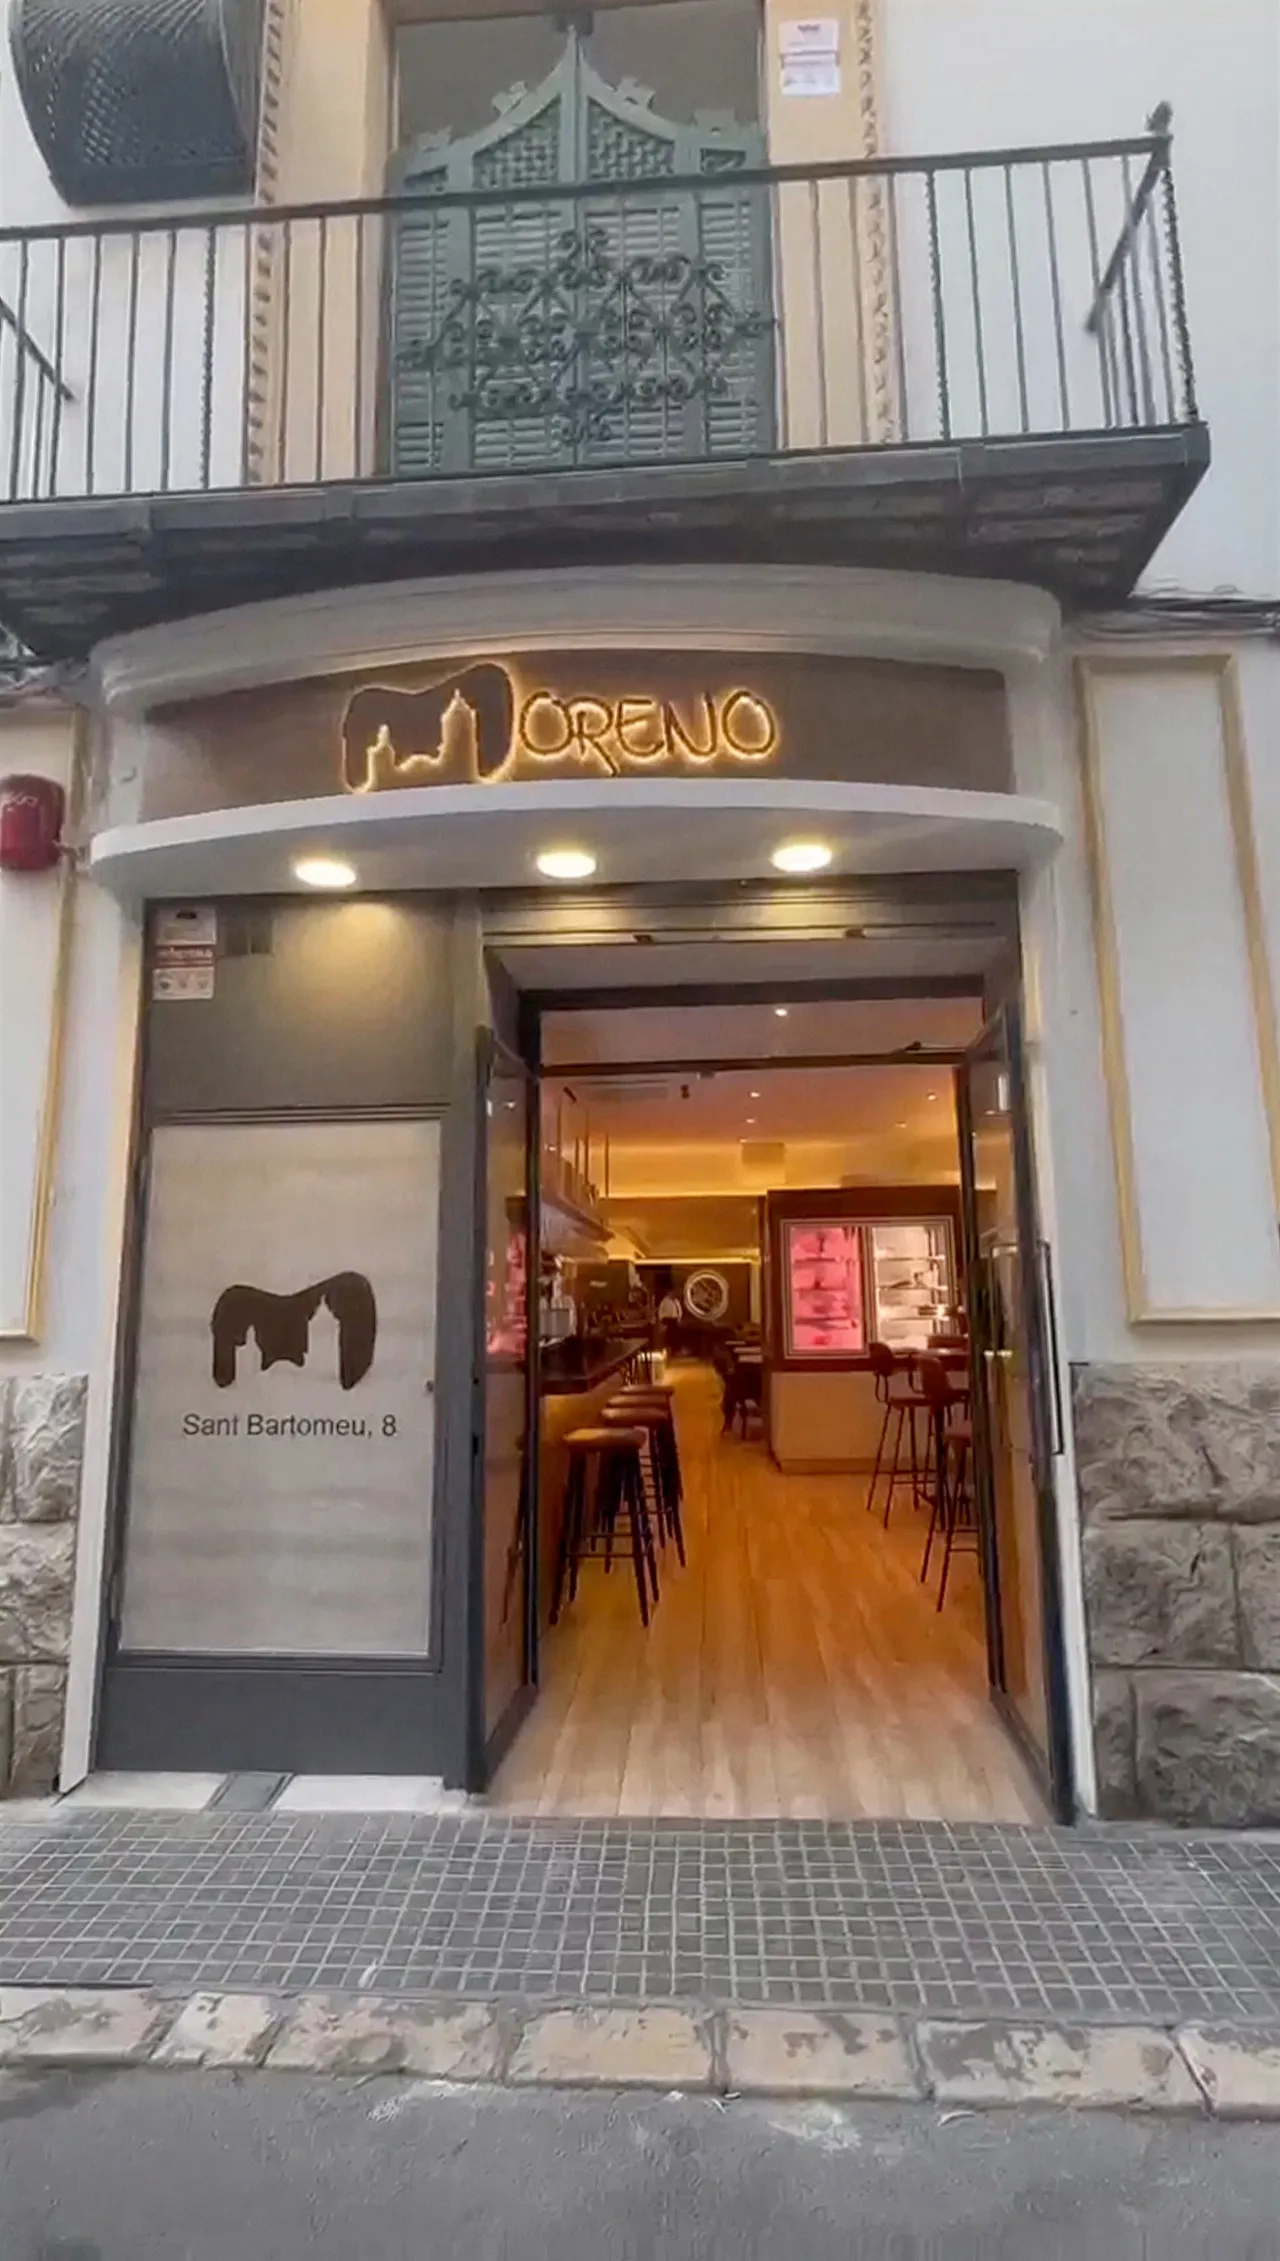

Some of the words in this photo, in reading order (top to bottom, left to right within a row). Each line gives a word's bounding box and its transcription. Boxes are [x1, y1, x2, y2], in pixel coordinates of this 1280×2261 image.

[182, 1413, 239, 1437] Sant
[246, 1413, 373, 1439] Bartomeu,
[382, 1414, 397, 1437] 8
